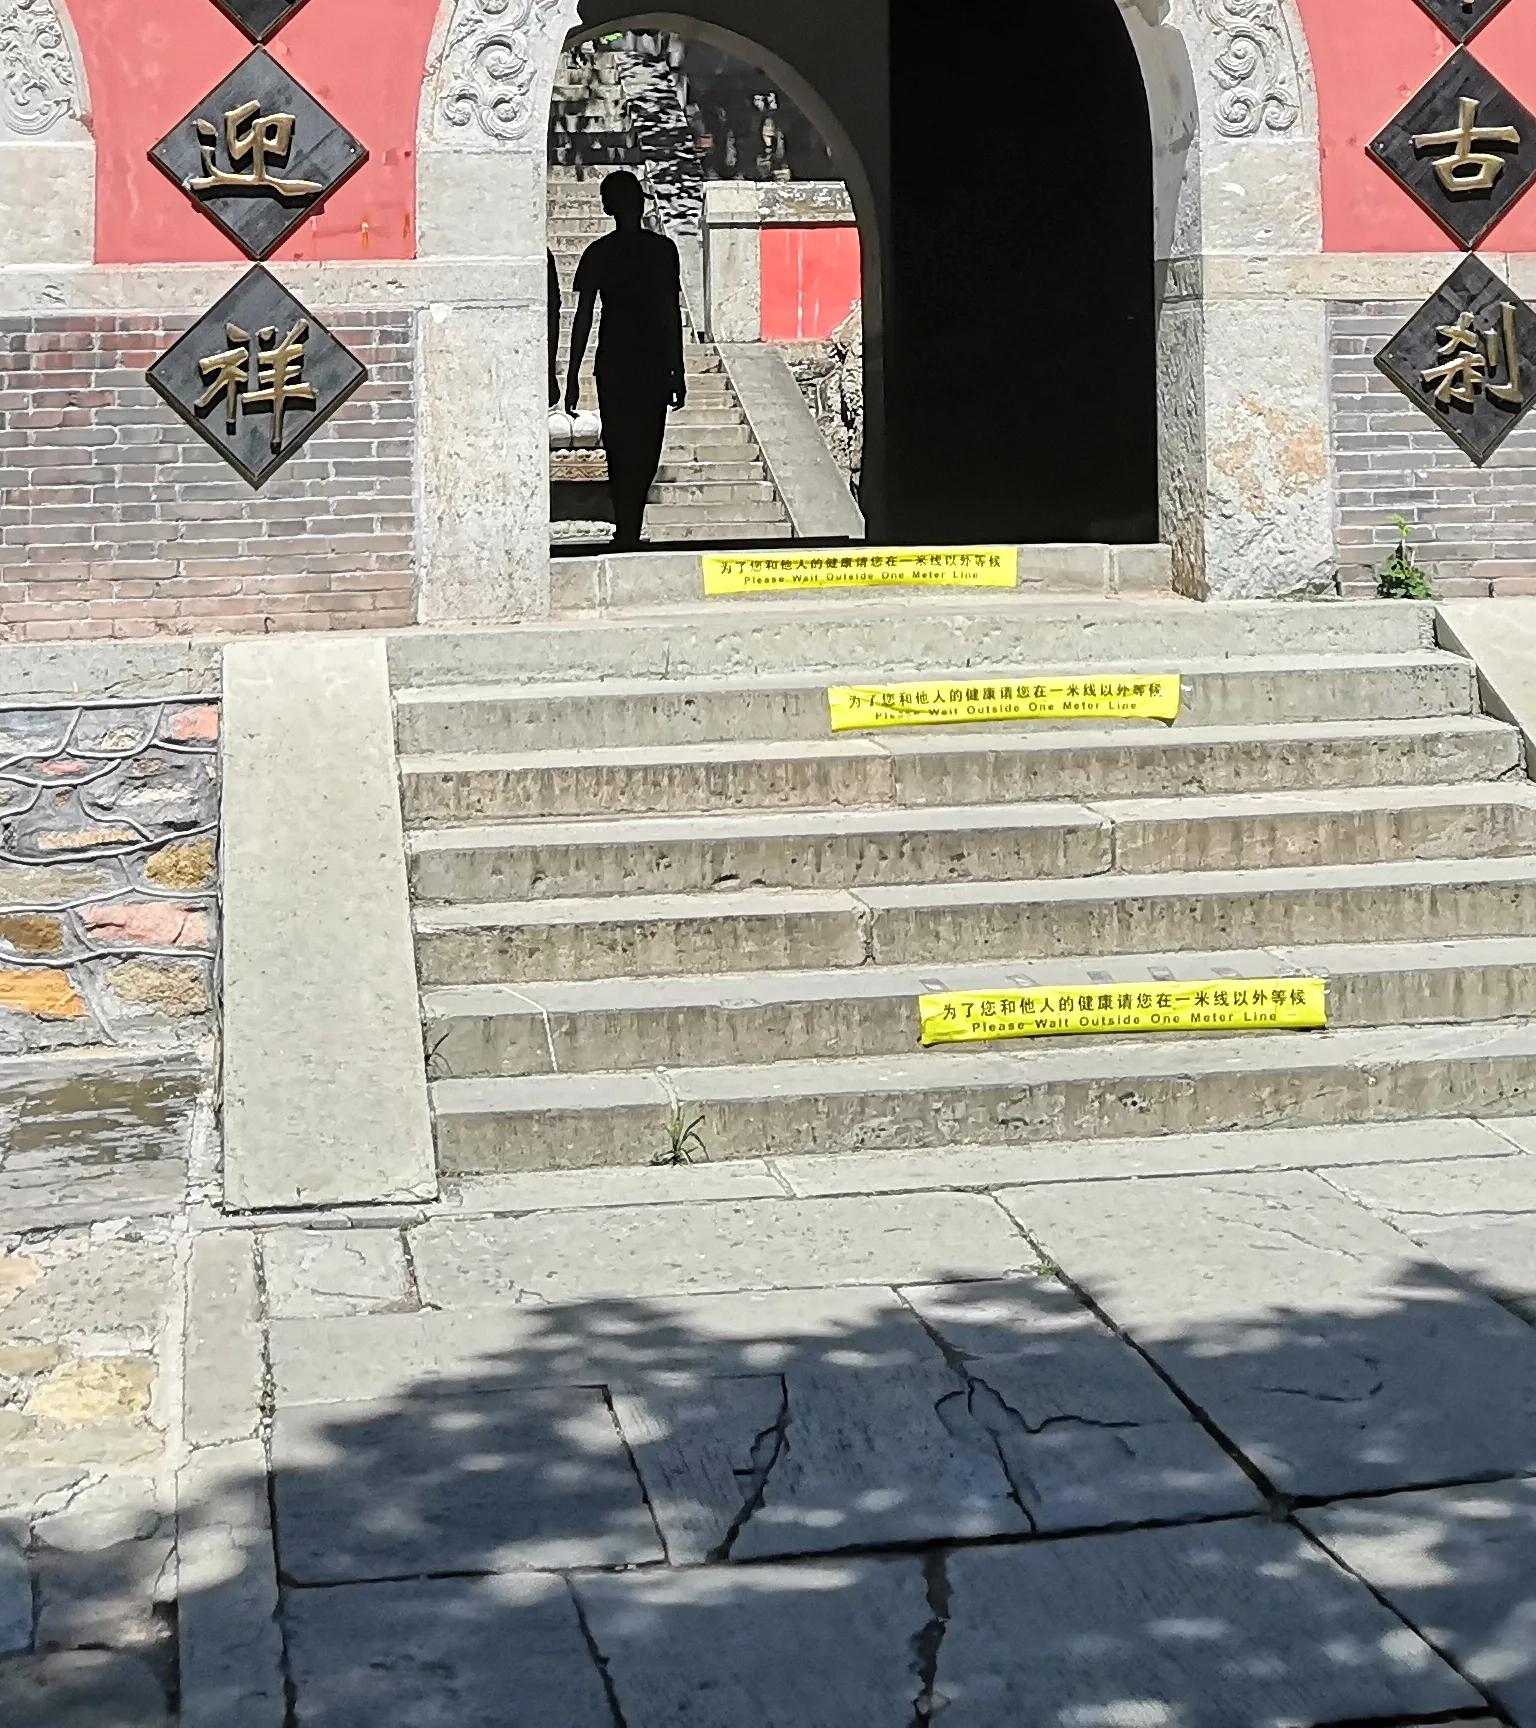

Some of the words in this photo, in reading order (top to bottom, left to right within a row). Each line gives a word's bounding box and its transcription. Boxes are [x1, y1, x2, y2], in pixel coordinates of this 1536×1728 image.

[744, 574, 785, 585] Please
[792, 573, 818, 582] Wait
[826, 572, 873, 581] Outside
[881, 571, 904, 580] One
[912, 570, 946, 579] Meter
[953, 570, 978, 579] Line
[966, 704, 1020, 714] Outside
[1028, 702, 1054, 712] One
[1063, 700, 1100, 711] Meter
[1108, 700, 1137, 710] Line
[942, 988, 1306, 1020] 为了您和他人的健康请您在一米线以外等候
[972, 1020, 1024, 1033] Please
[1035, 1017, 1069, 1029] Wait
[1079, 1014, 1140, 1027] Outside
[1150, 1013, 1180, 1024] One
[1190, 1011, 1234, 1023] Meter
[1243, 1010, 1277, 1022] Line
